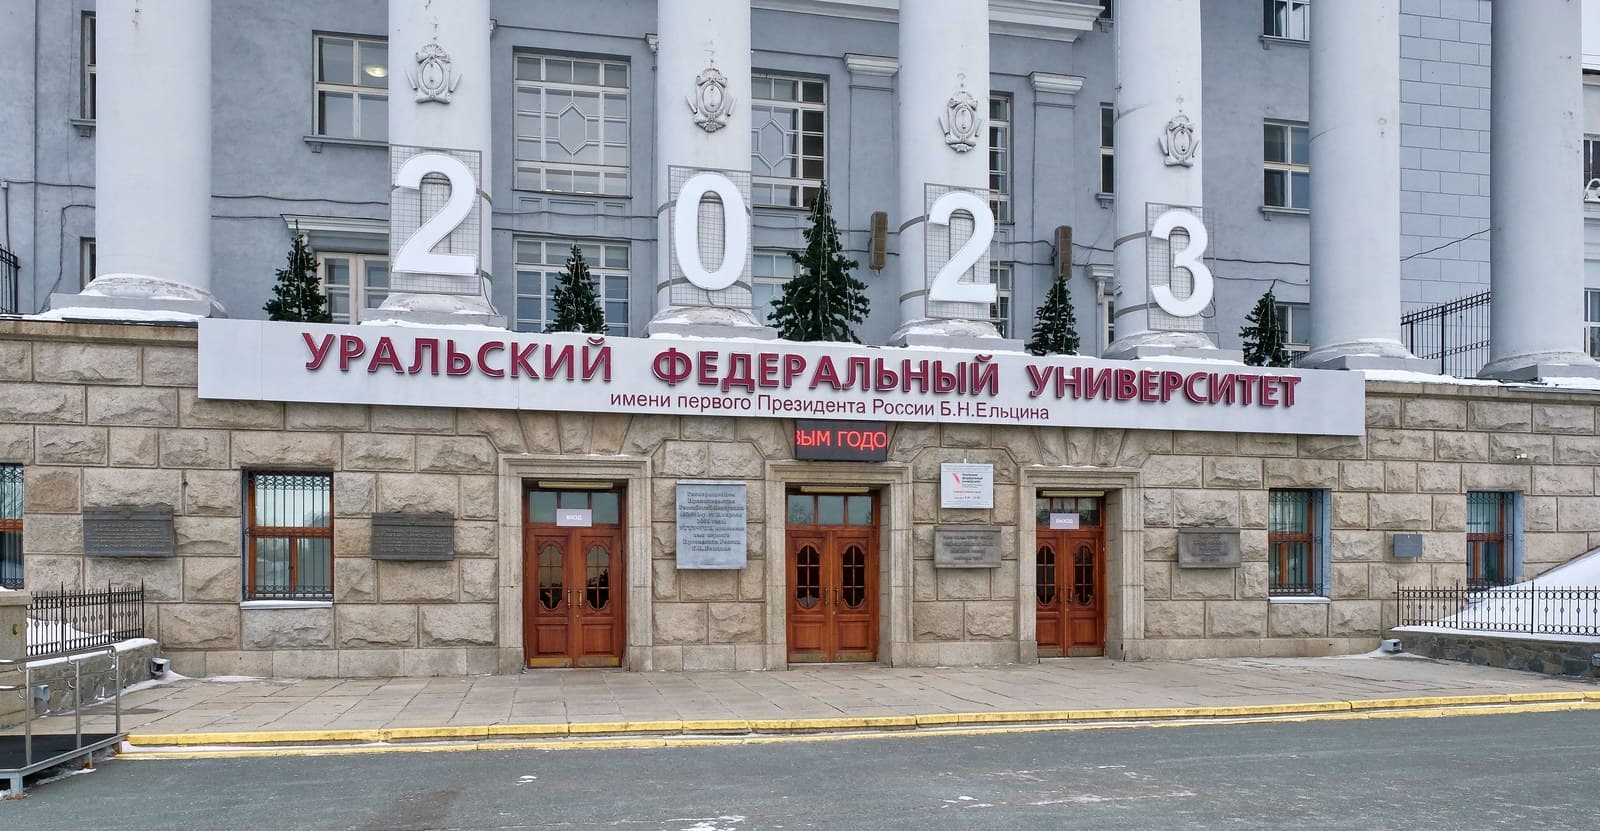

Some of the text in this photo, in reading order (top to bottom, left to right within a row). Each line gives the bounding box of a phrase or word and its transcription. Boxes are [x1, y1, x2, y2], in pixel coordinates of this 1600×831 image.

[301, 332, 1301, 408] УРАЛЬСКИЙ ФЕДЕРАЛЬНЫЙ УНИВЕРСИТЕТ
[610, 393, 1049, 421] имени первого Президента России Б.Н.Ельцина
[837, 430, 887, 451] ГОДО
